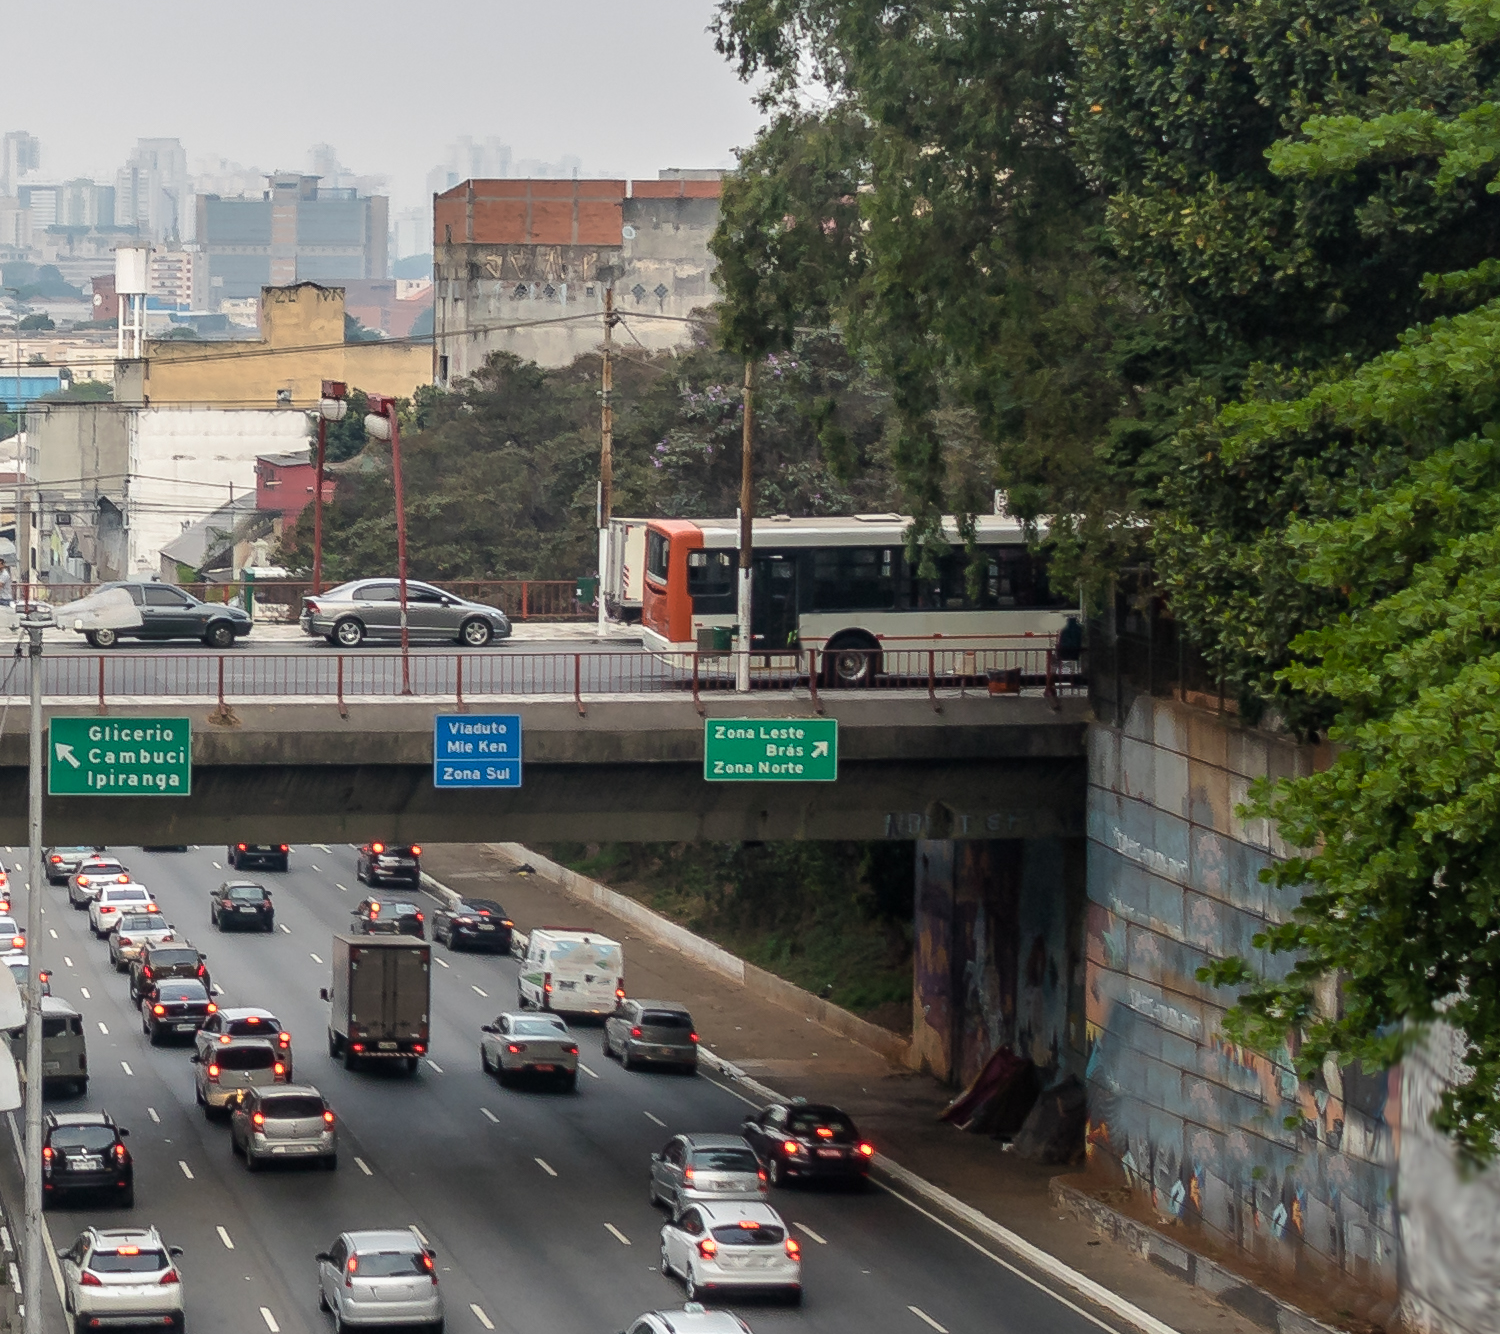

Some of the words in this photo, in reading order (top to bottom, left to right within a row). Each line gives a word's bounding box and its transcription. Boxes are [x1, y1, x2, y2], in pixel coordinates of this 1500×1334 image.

[88, 723, 173, 741] Glicerio
[448, 722, 507, 735] Viaduto
[714, 726, 755, 739] Zona
[759, 726, 804, 739] Leste
[447, 740, 473, 753] Mie
[478, 740, 507, 753] Ken
[766, 743, 804, 757] Brás
[88, 746, 185, 764] Cambuci
[443, 767, 481, 780] Zona
[486, 767, 510, 780] Sul
[713, 761, 754, 774] Zona
[758, 761, 804, 774] Norte
[87, 768, 180, 790] Ipiranga
